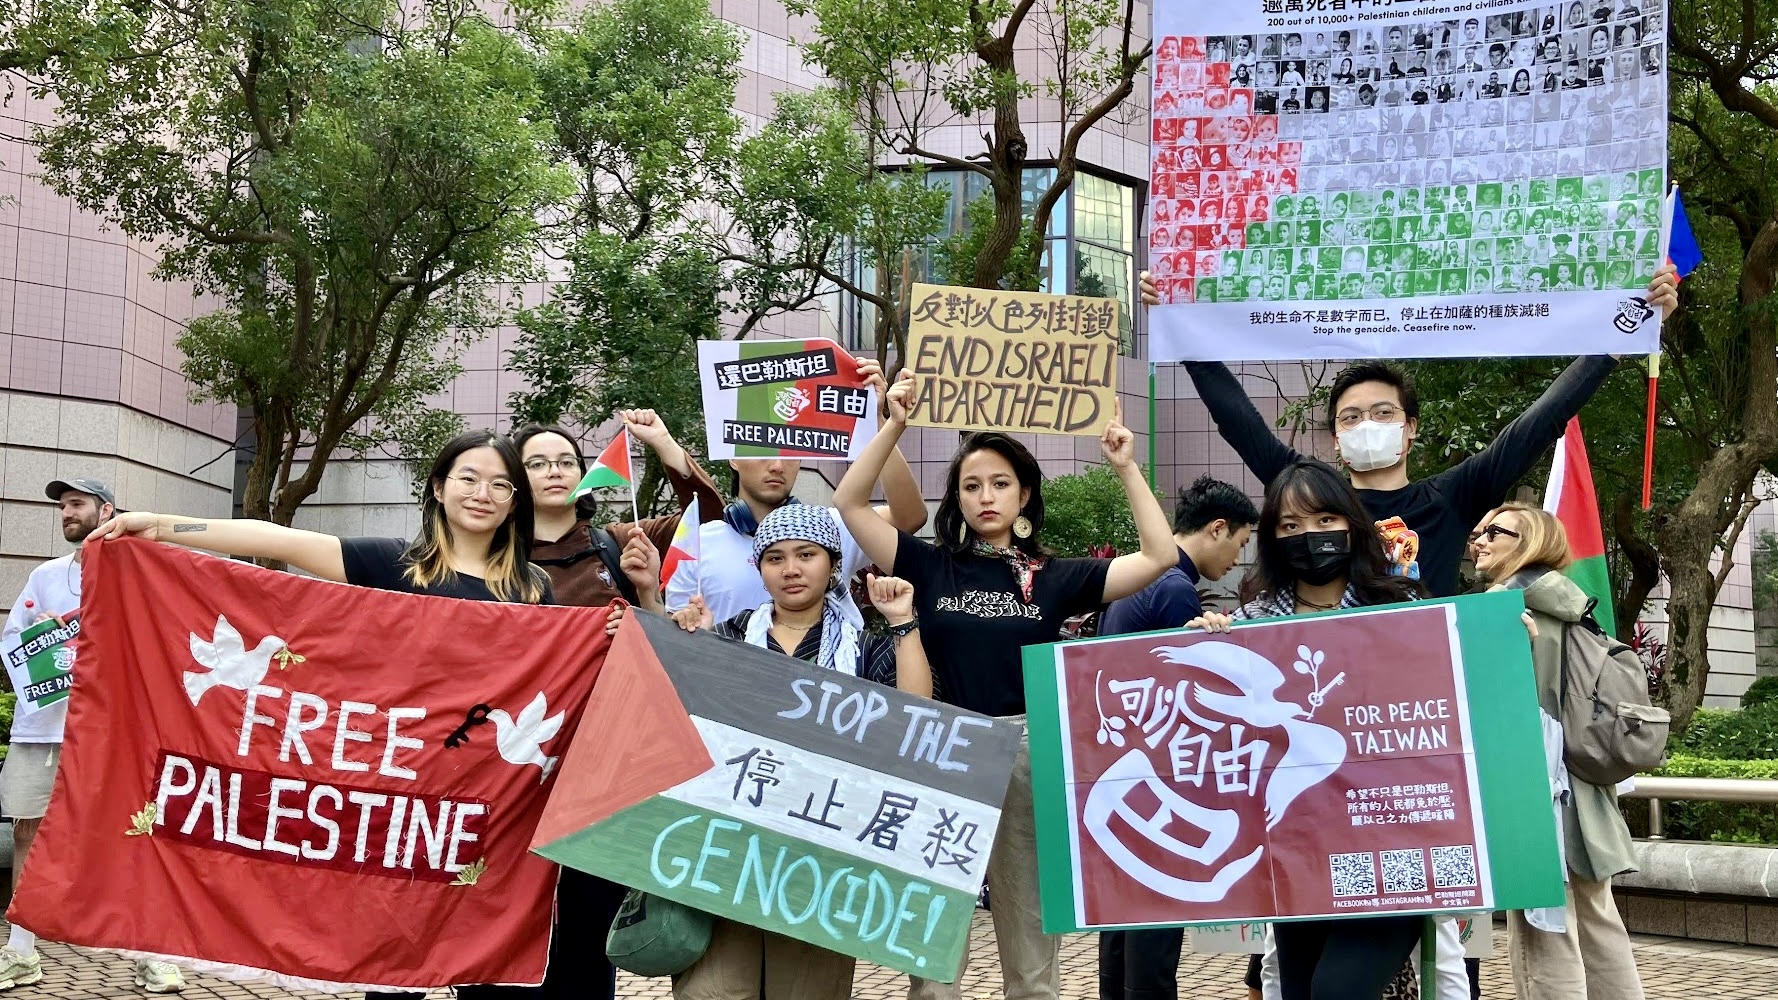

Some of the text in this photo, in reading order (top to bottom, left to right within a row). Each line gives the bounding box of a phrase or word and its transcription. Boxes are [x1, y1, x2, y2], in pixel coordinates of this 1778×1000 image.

[1267, 0, 1514, 27] 200 out of 10,000+ Palestinian children and civilians
[912, 290, 1120, 341] 反對以色列封鎖
[1312, 322, 1477, 336] Stop the genocide. Ceasefire now.
[717, 354, 831, 388] 還巴勒斯坦
[915, 334, 1117, 387] END ISRAELI
[818, 385, 867, 415] 自由
[908, 376, 1101, 433] APARTHEID
[723, 422, 849, 453] FREE PALESTINE
[24, 680, 55, 700] FREE
[1344, 699, 1451, 726] FOR PEACE
[237, 684, 428, 780] FREE
[776, 677, 994, 772] STOP THE
[1351, 725, 1448, 755] TAIWAN
[1167, 722, 1270, 797] 自由
[155, 755, 488, 873] PALESTINE
[725, 746, 979, 876] 停止屠殺
[650, 814, 947, 967] GENOCIDE!
